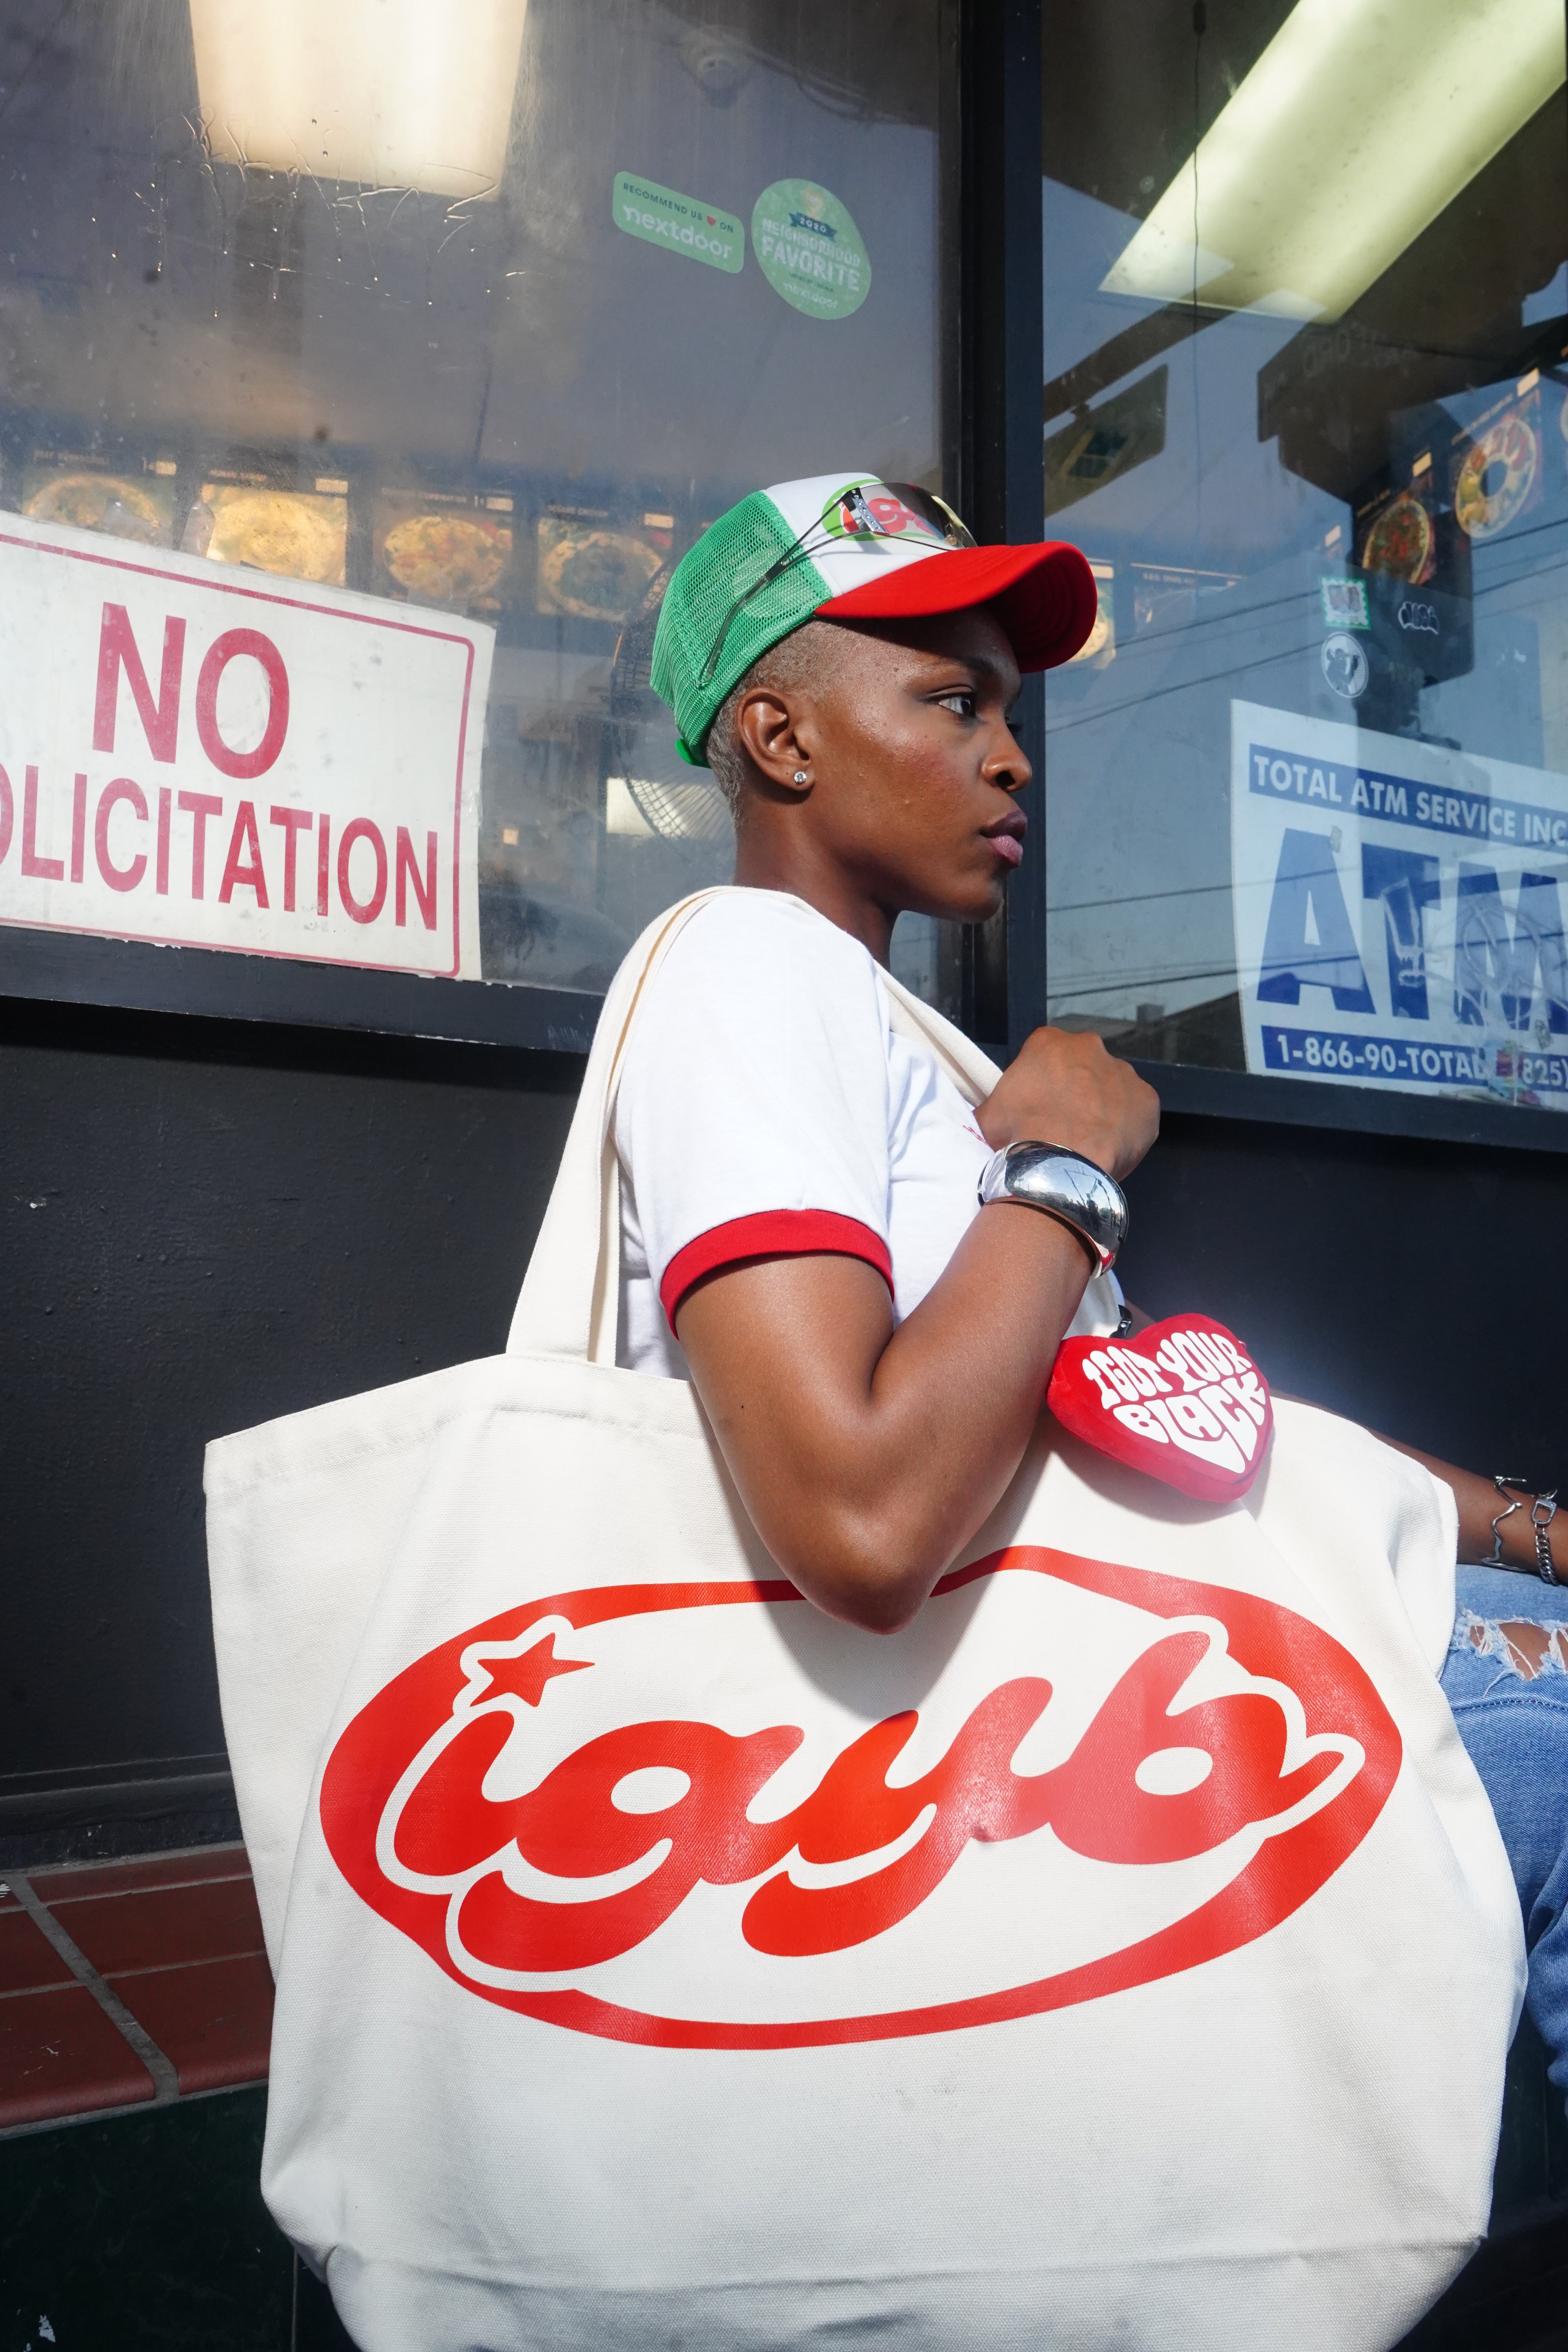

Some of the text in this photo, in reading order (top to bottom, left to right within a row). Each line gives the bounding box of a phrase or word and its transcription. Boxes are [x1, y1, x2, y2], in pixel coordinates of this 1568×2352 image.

[622, 204, 732, 259] nextdoor
[623, 183, 733, 233] RECOMMEND US ON
[800, 217, 826, 233] 2020
[762, 218, 861, 267] NEIGHBORHOOD
[762, 235, 860, 292] FAVORITE
[93, 601, 290, 779] NO
[1254, 754, 1341, 803] TOTAL
[1350, 777, 1408, 816] ATM
[1416, 795, 1515, 838] SERVICE
[0, 762, 438, 931] LICITATION
[1256, 827, 1568, 1034] ATM
[1277, 1035, 1486, 1079] 1-866-90-TOTAL
[1082, 1330, 1252, 1409] I GOT YOUR
[1113, 1371, 1266, 1474] BLACK
